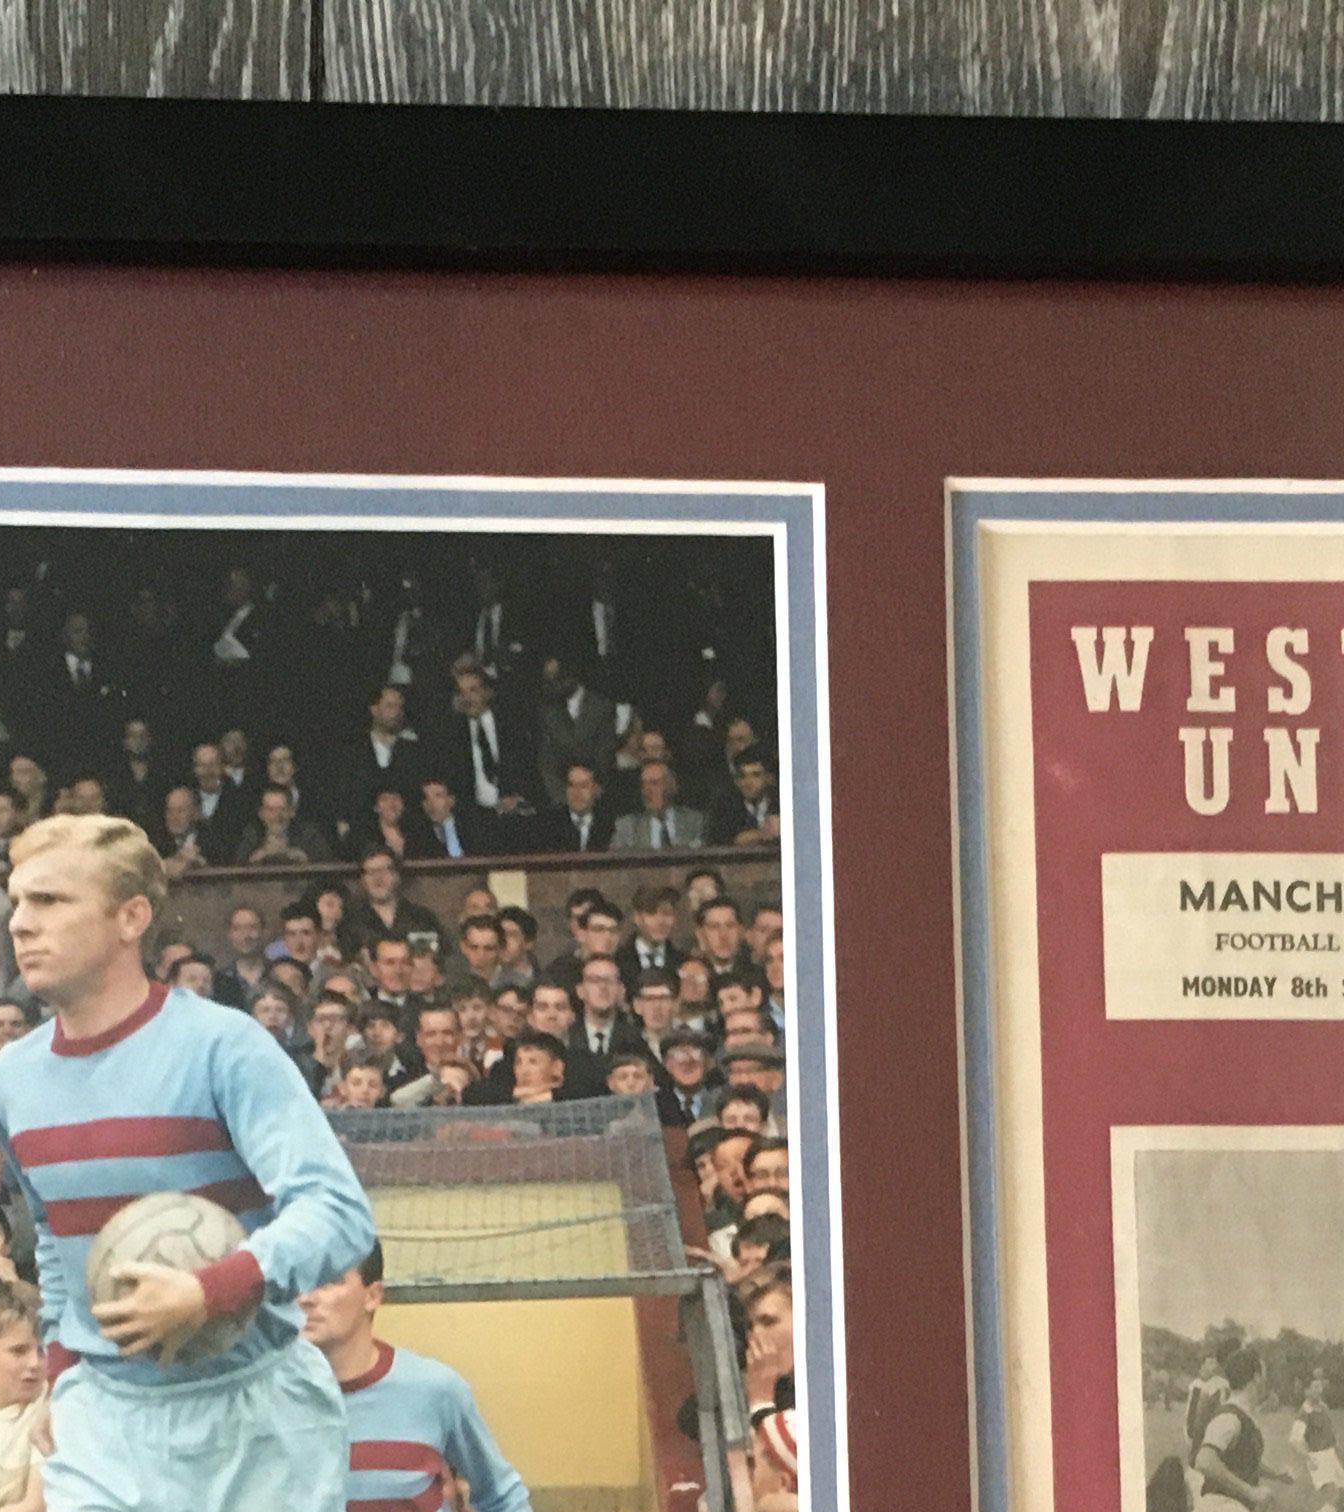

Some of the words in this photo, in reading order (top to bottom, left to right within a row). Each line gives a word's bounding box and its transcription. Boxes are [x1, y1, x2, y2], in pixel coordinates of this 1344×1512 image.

[1214, 932, 1342, 953] FOOTBALL
[1181, 975, 1278, 999] MONDAY
[1290, 975, 1329, 999] 8th
